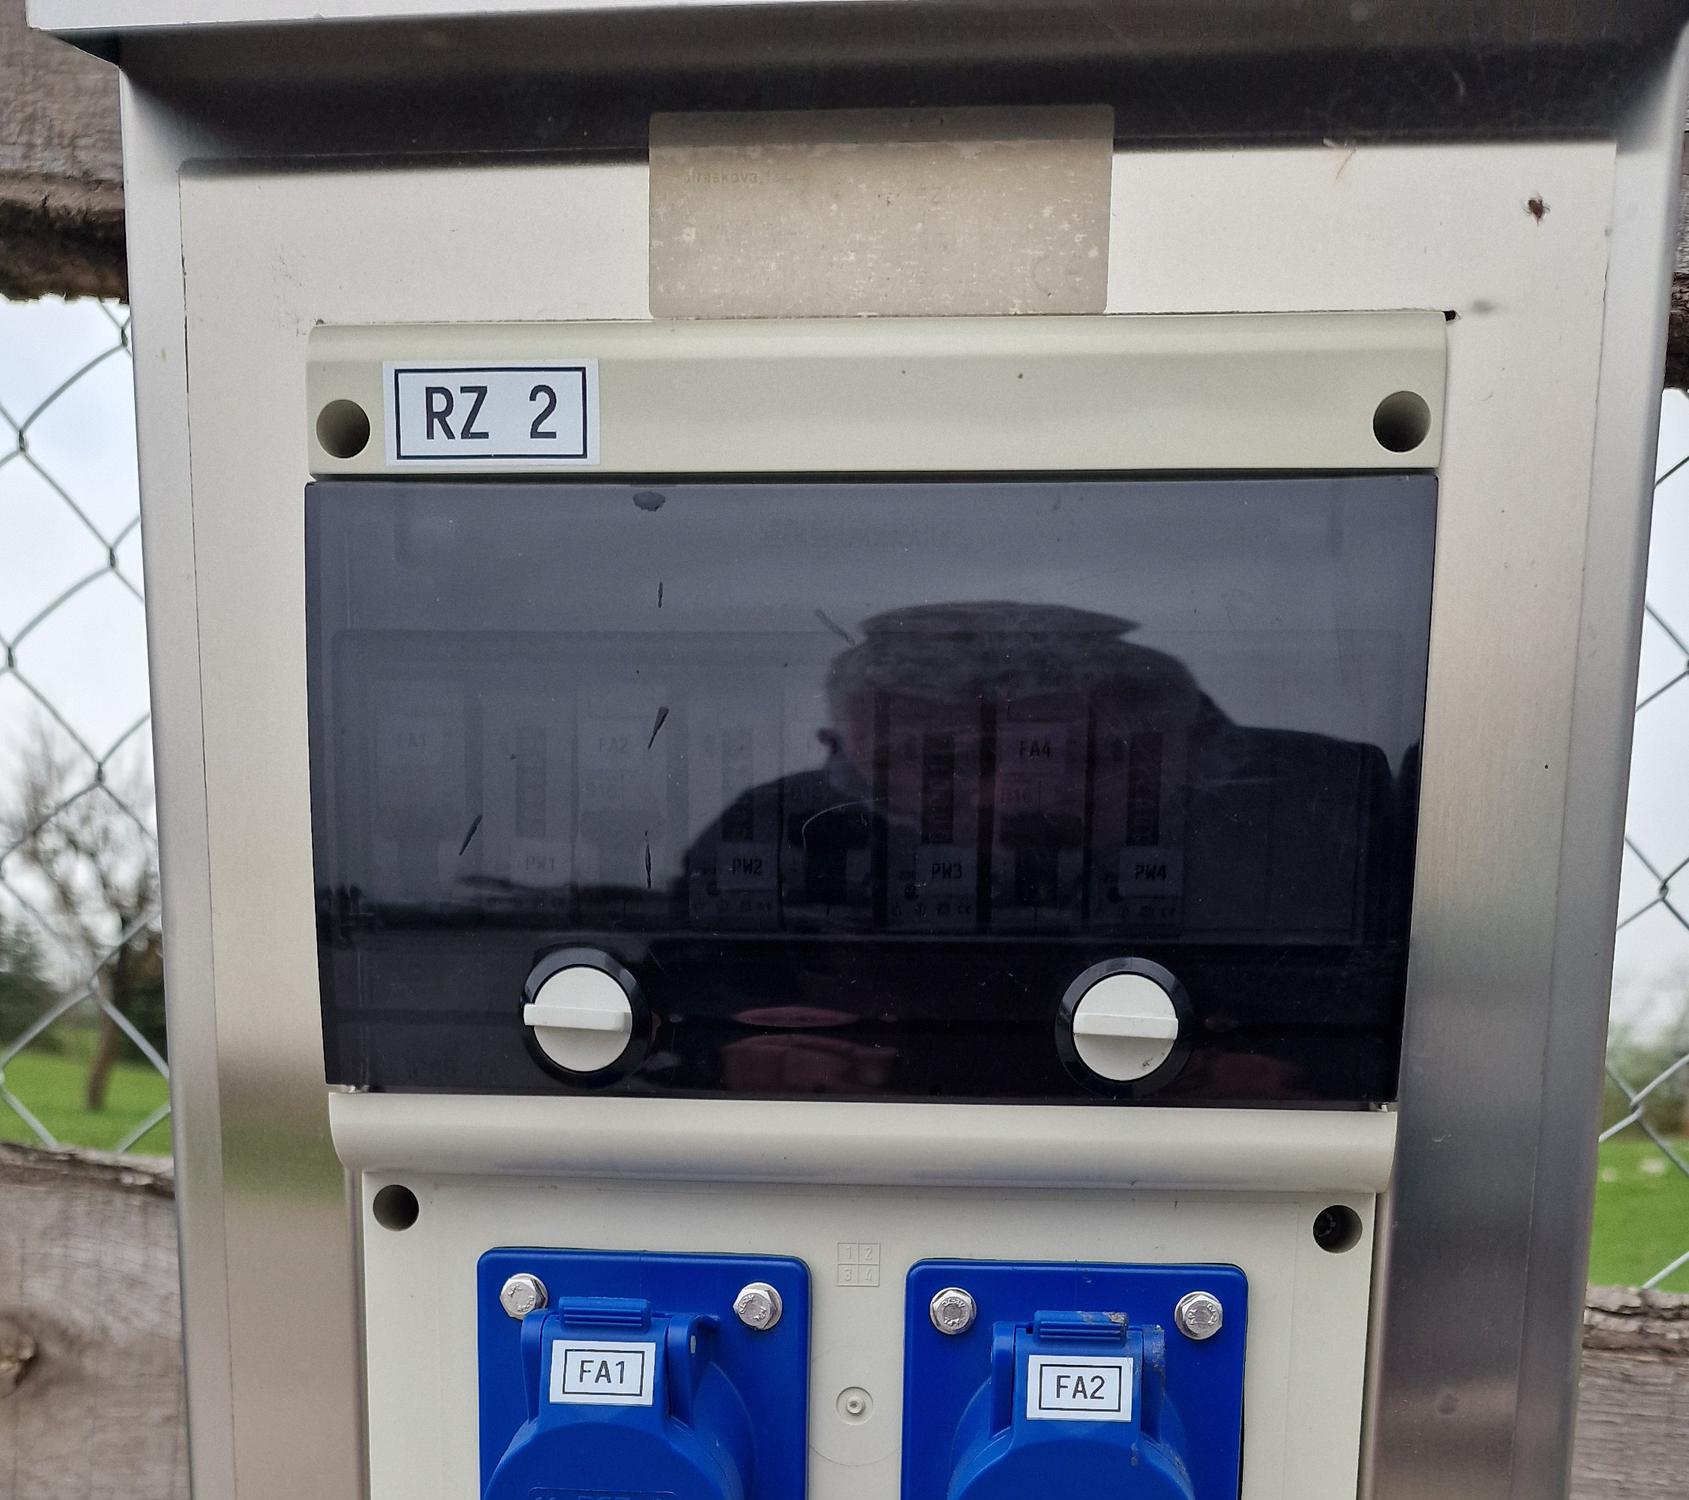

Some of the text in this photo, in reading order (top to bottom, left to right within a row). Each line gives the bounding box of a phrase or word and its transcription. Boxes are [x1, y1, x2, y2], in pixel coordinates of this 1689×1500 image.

[425, 384, 558, 440] RZ 2
[1019, 740, 1053, 758] FA4
[525, 856, 556, 871] PW1
[732, 859, 764, 876] PW2
[931, 862, 963, 879] PW3
[1134, 864, 1168, 881] PW4
[579, 1360, 626, 1385] FA1
[1056, 1375, 1105, 1400] FA2
